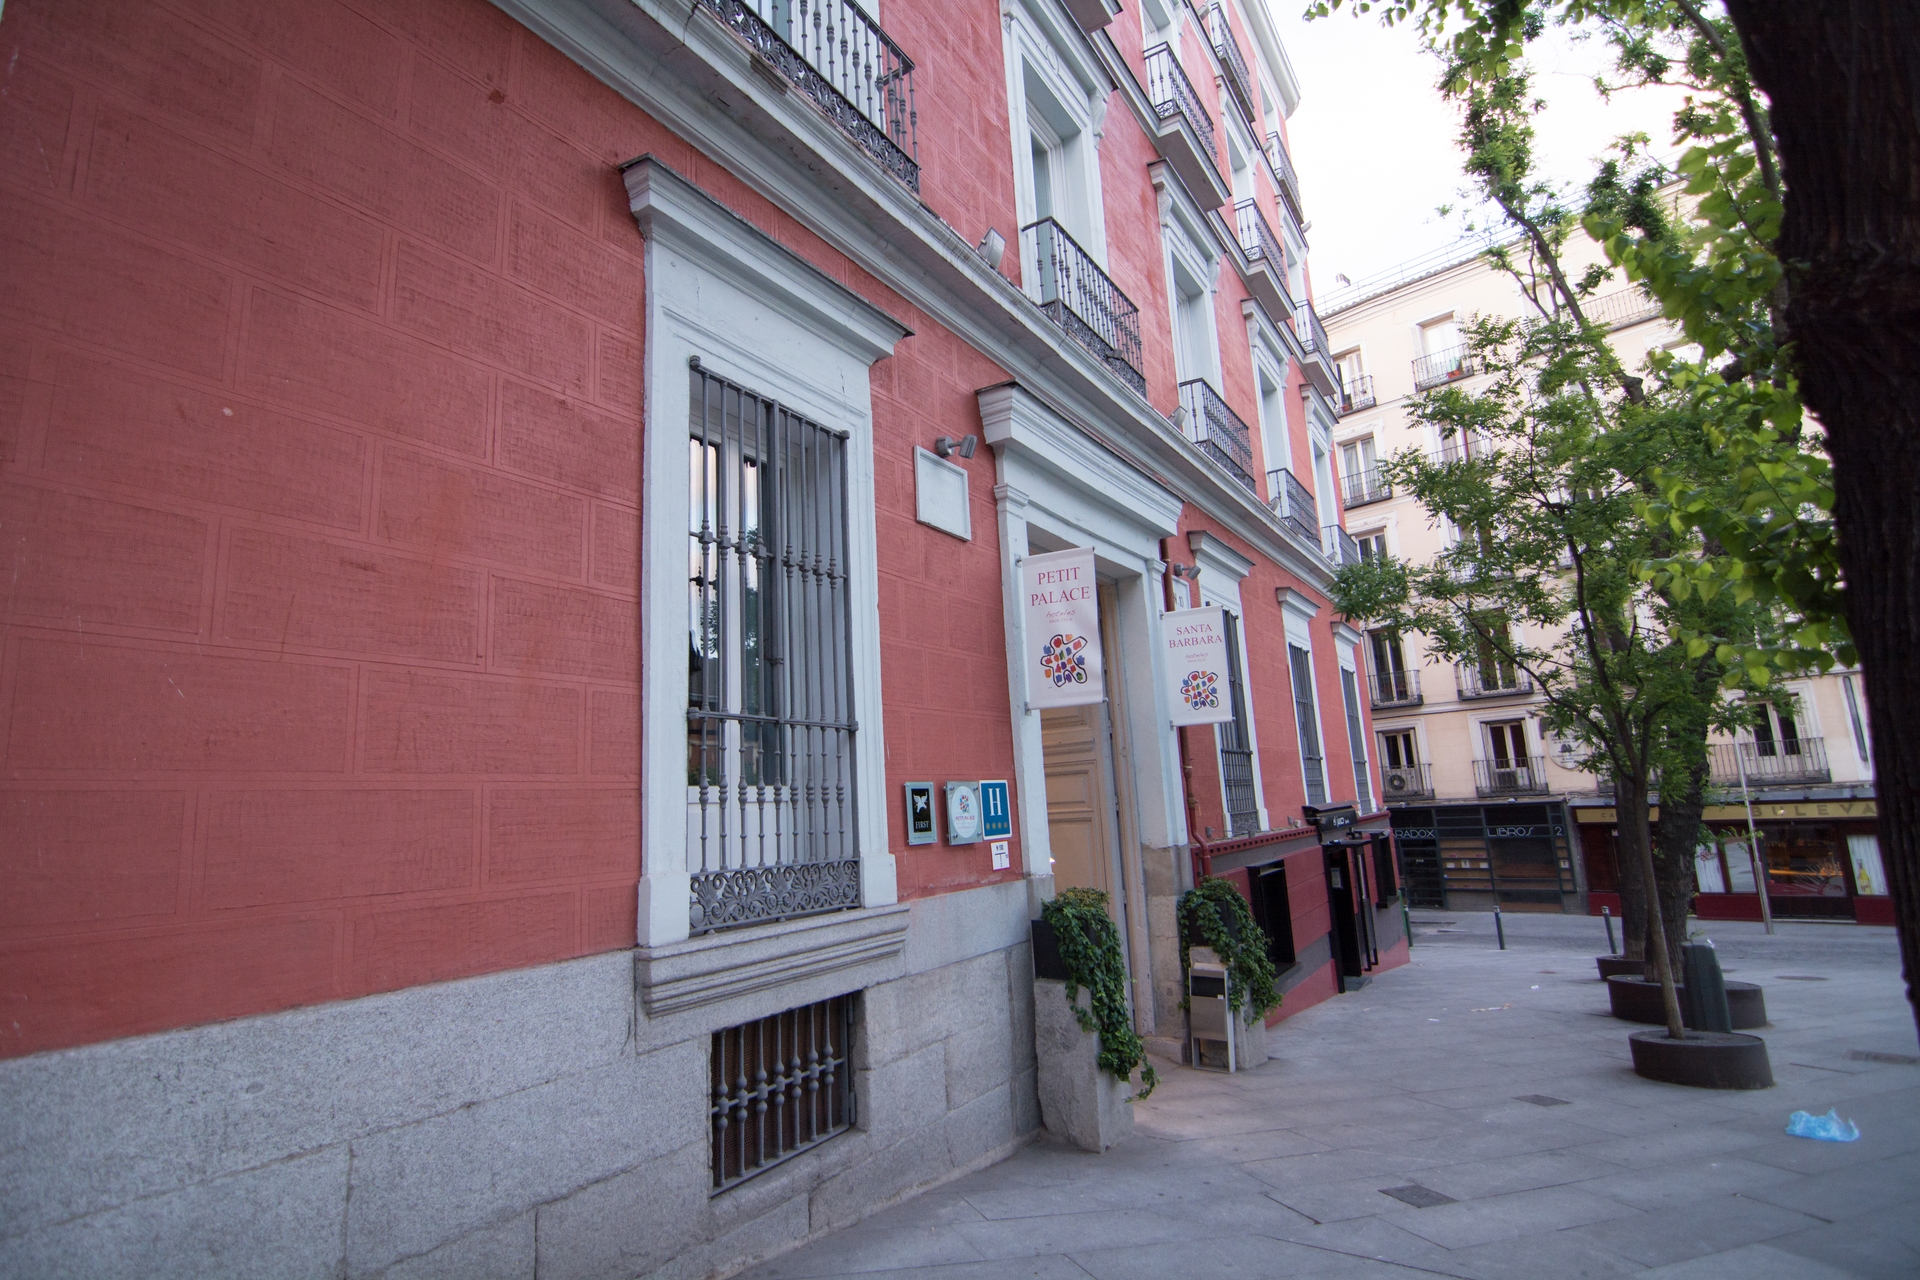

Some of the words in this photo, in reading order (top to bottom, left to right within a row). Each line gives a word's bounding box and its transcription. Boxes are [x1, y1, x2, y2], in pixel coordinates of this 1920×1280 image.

[1037, 567, 1080, 585] PETIT
[1031, 586, 1090, 606] PALACE
[1045, 609, 1076, 618] hoteles
[1176, 624, 1212, 636] SANTA
[1169, 635, 1223, 648] BARBARA
[1751, 803, 1876, 817] BULEVA
[915, 821, 929, 829] FIRST
[1554, 826, 1563, 836] 2
[1487, 827, 1534, 837] LIBROS
